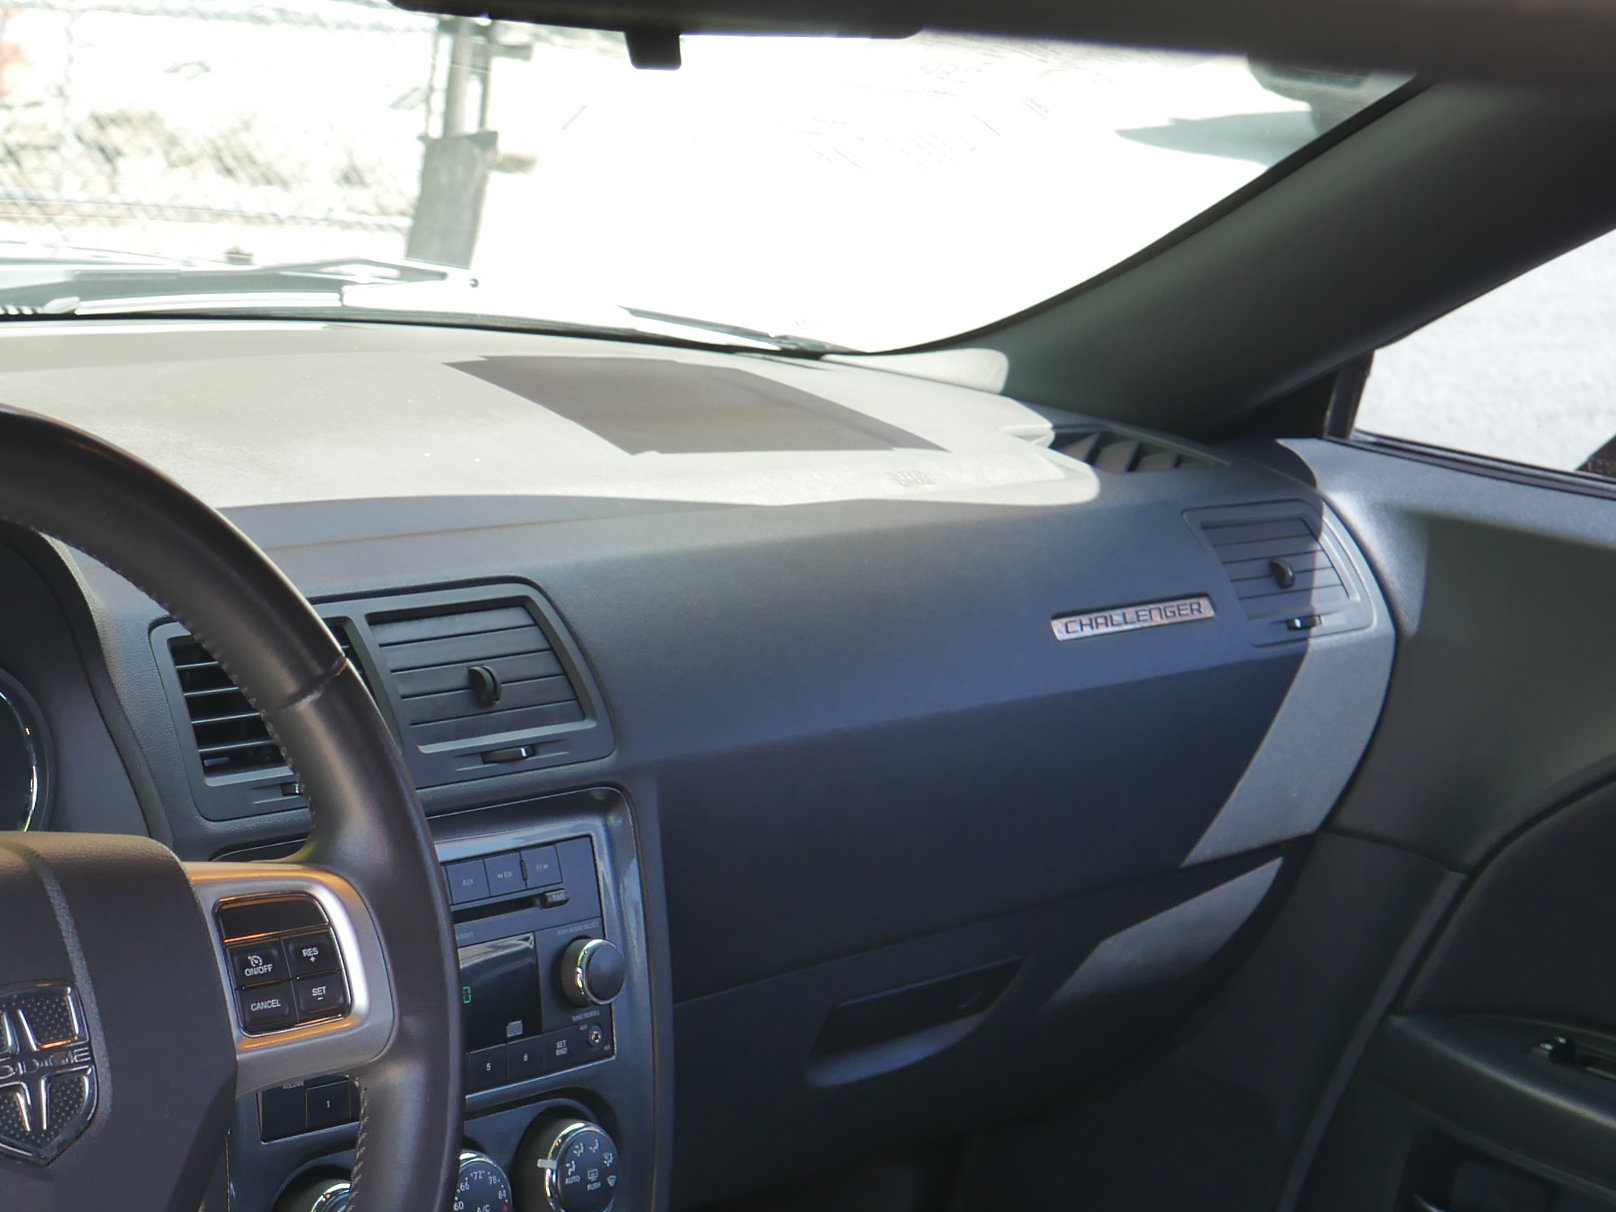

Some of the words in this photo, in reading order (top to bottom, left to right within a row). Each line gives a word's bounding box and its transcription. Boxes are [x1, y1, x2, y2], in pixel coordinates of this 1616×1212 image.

[1064, 601, 1204, 634] CHALLENGER
[301, 946, 319, 957] RES
[244, 963, 273, 977] ON/OFF
[311, 986, 327, 997] SET
[250, 998, 282, 1012] CANCEL
[485, 1062, 492, 1072] 5
[564, 1174, 581, 1185] AUTO
[453, 1200, 464, 1211] 60
